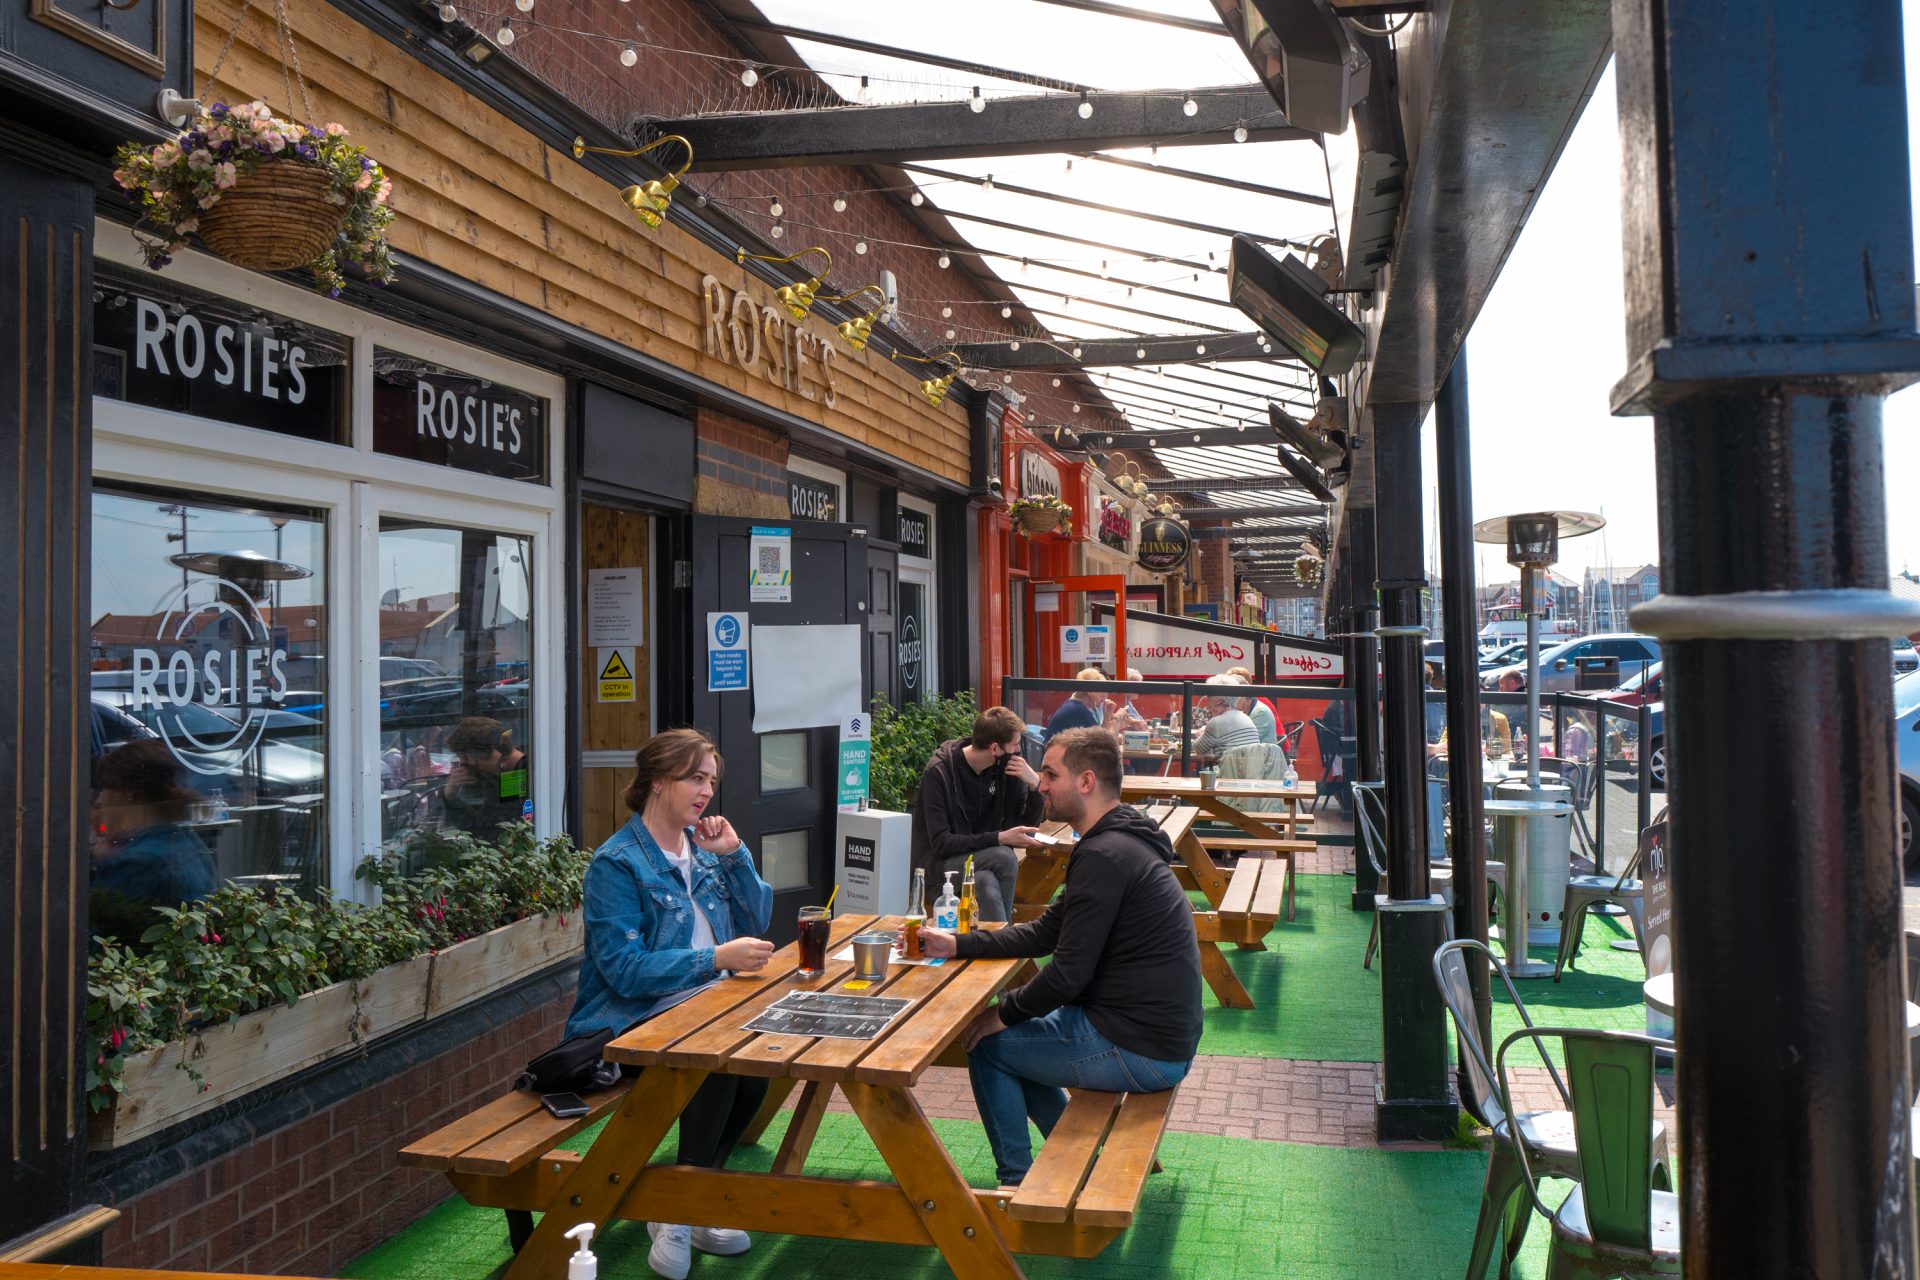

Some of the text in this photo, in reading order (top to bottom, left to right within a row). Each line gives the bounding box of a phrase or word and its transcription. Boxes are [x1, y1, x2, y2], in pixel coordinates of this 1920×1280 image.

[136, 297, 307, 405] ROSIE'S
[703, 274, 837, 410] ROSIE'S
[417, 380, 521, 455] ROSIE'S
[792, 485, 829, 520] ROSIE'S
[901, 518, 924, 545] ROSIE'S
[899, 639, 921, 667] ROSIE'S
[133, 648, 287, 712] ROSIE'S
[843, 750, 866, 759] HAND
[848, 844, 872, 856] HAND
